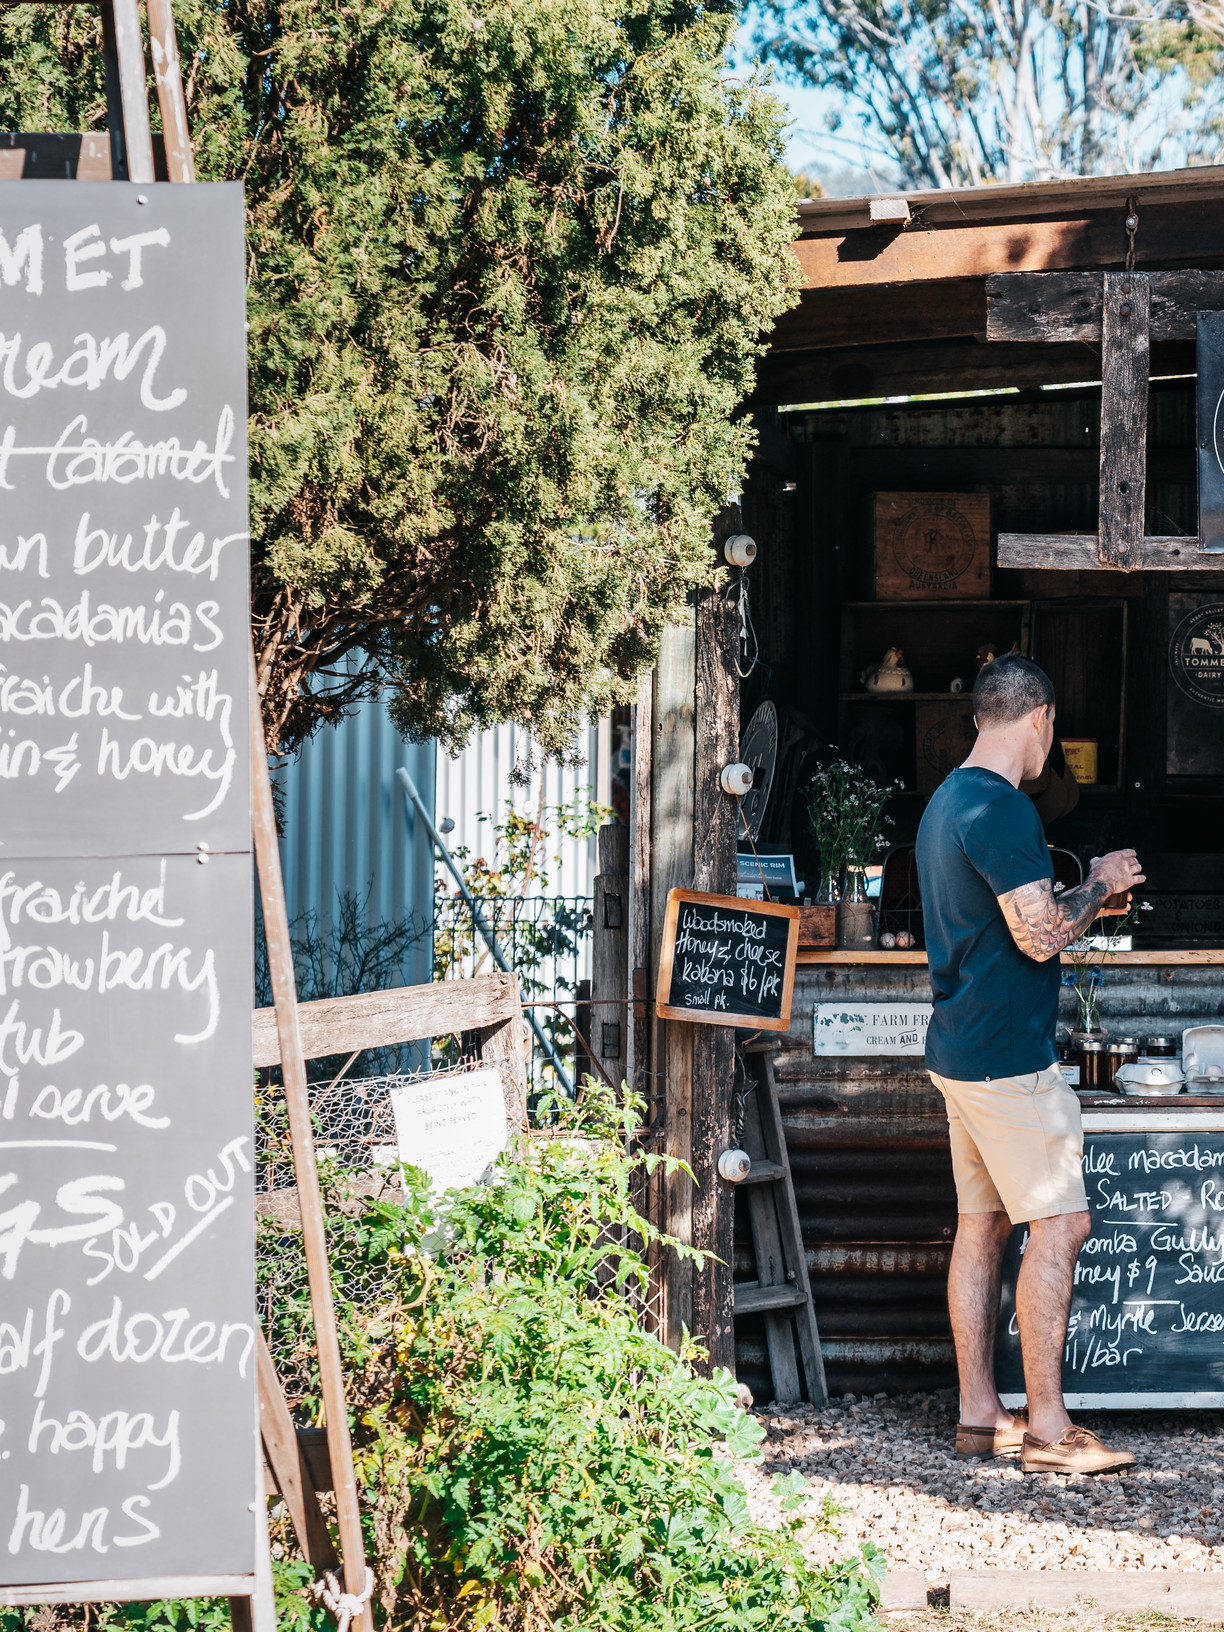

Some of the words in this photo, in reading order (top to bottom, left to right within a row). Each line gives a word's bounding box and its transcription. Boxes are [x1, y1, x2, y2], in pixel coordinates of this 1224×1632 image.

[74, 507, 250, 581] butter
[1197, 671, 1222, 679] DAIRY
[0, 662, 142, 720] raiche
[148, 668, 232, 748] with
[98, 728, 236, 821] honey
[739, 860, 769, 868] SCENIC
[682, 909, 767, 939] Woodsmoked
[1155, 899, 1220, 910] POTATOES
[1171, 922, 1222, 932] ONIONS
[675, 929, 719, 966] Honey
[735, 937, 782, 967] cheese
[684, 988, 711, 1005] small
[866, 1035, 896, 1045] CREAM
[899, 1033, 918, 1045] AND
[872, 1014, 908, 1026] FARM
[29, 1083, 171, 1129] serve
[82, 1203, 177, 1287] SOLD
[184, 1136, 251, 1212] OUT
[1096, 1178, 1173, 1212] SALTED
[1126, 1255, 1157, 1295] $9
[77, 1296, 255, 1379] dozen
[1090, 1304, 1158, 1348] Myrtle
[28, 1400, 181, 1490] happy
[8, 1484, 161, 1554] hens
